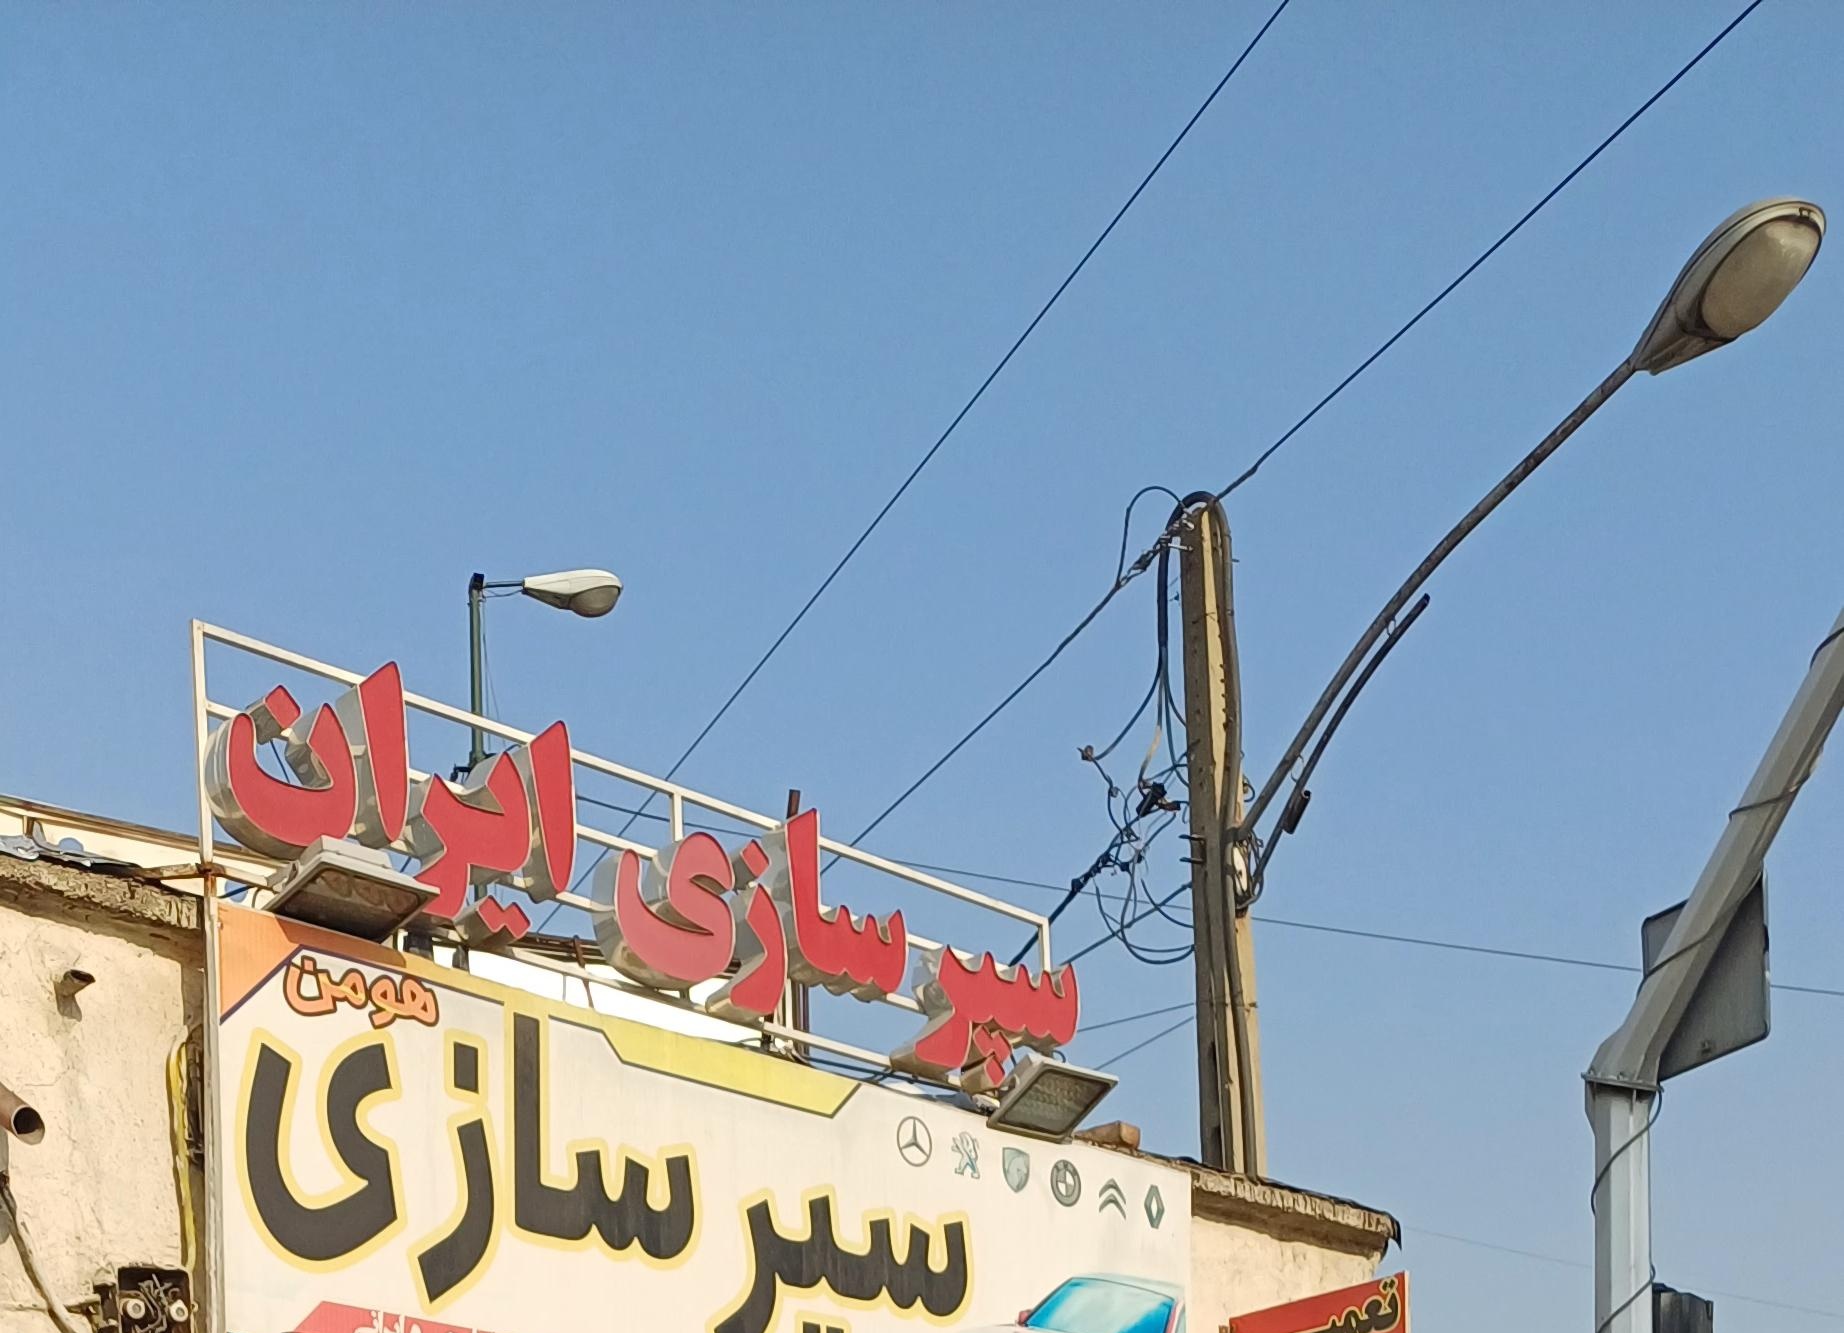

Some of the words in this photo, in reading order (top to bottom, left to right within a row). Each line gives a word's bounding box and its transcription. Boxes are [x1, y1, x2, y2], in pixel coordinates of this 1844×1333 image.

[216, 660, 577, 941] ایران
[284, 951, 440, 1028] هومن
[608, 808, 907, 1016] سازی
[912, 944, 1080, 1090] سپر
[243, 1010, 697, 1305] سازی
